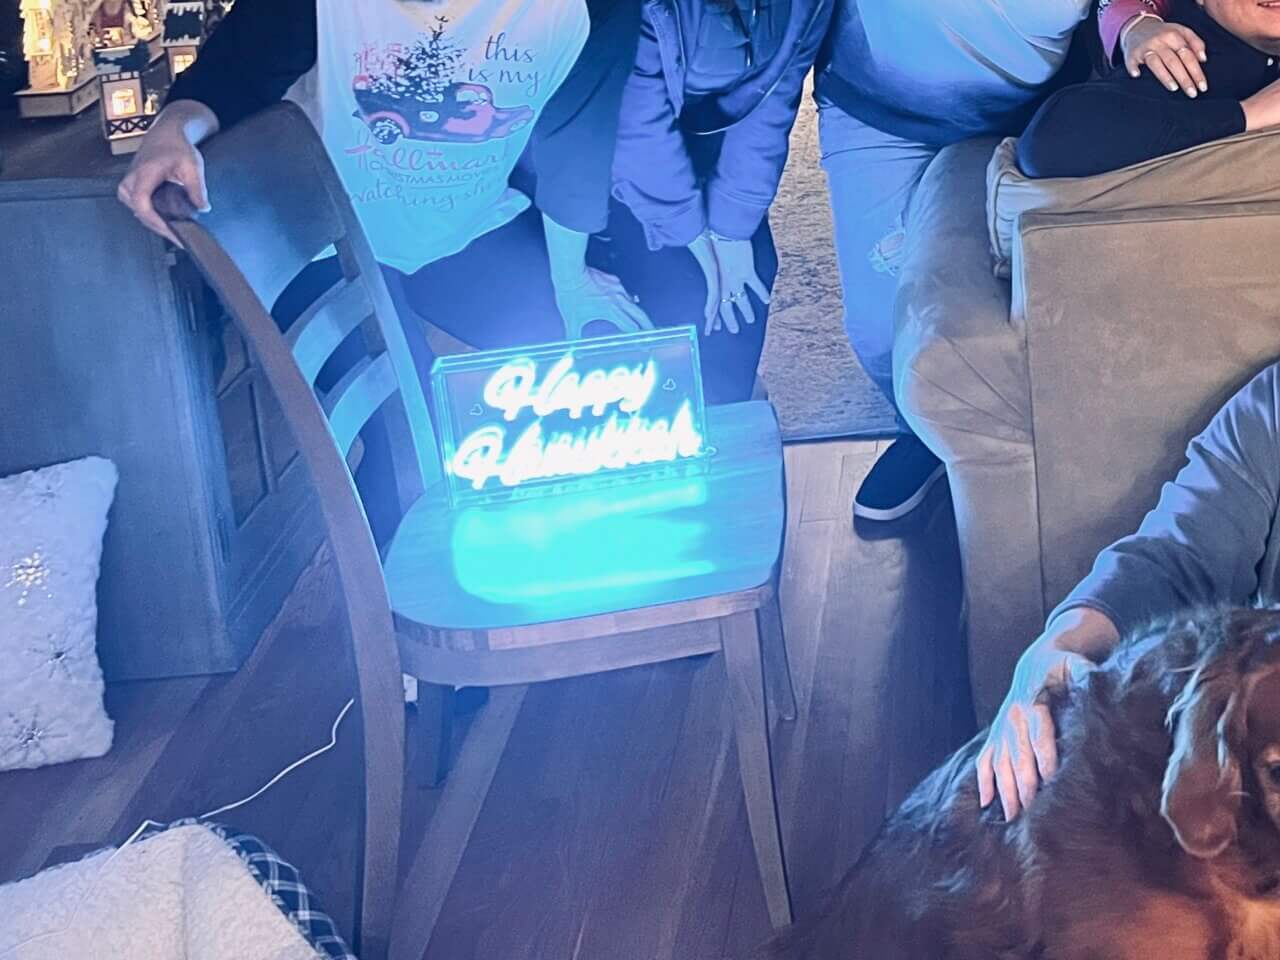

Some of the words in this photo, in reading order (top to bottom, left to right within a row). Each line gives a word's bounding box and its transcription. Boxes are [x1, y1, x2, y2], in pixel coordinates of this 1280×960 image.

[484, 32, 537, 64] this
[467, 66, 490, 82] is
[498, 67, 541, 96] my
[386, 168, 445, 184] STMAS
[483, 351, 657, 422] Happy
